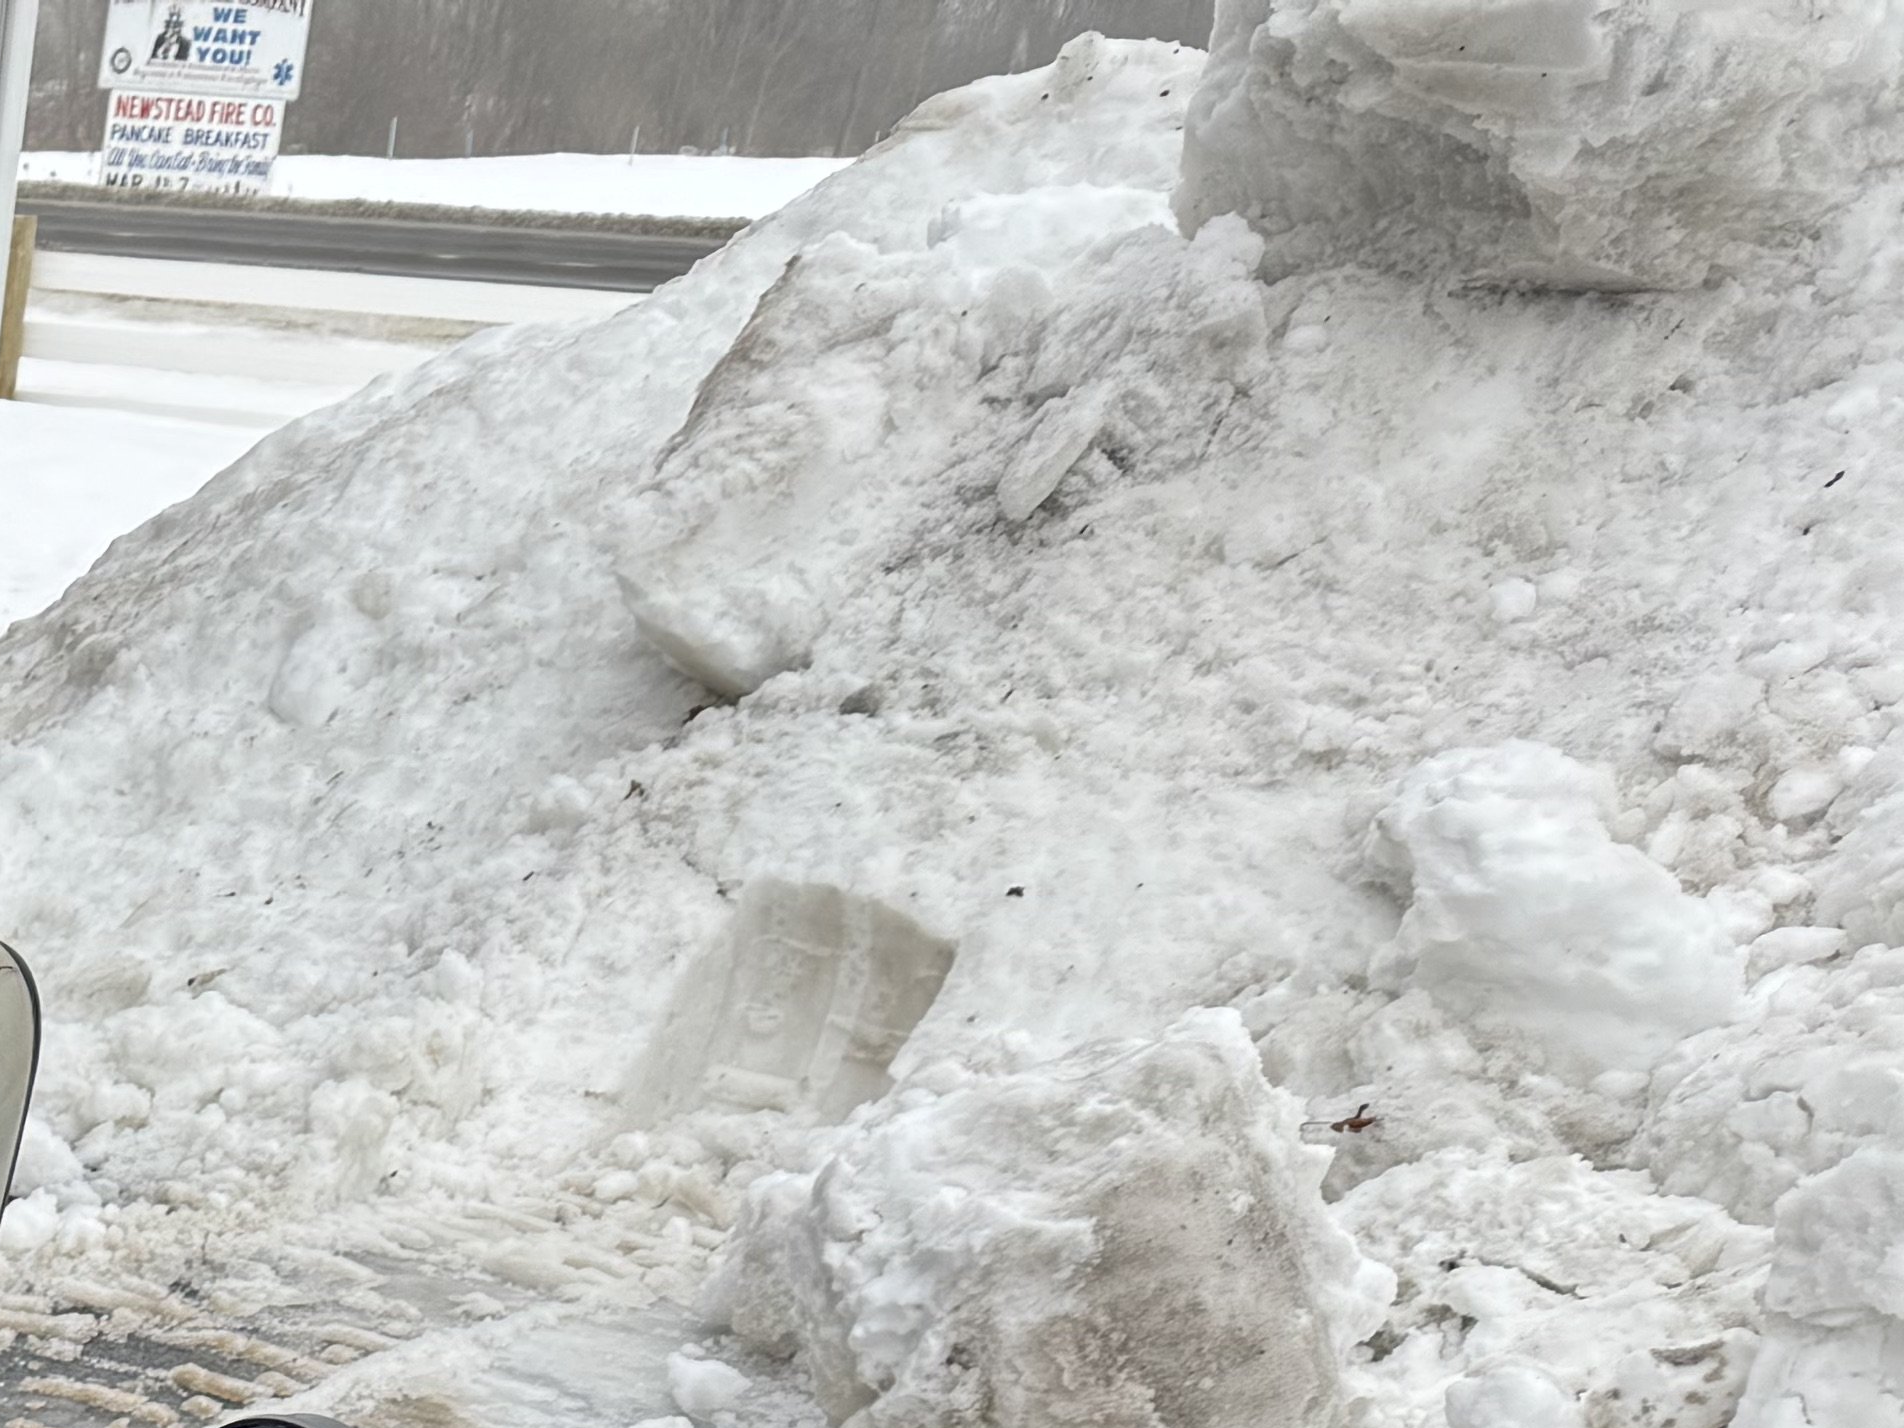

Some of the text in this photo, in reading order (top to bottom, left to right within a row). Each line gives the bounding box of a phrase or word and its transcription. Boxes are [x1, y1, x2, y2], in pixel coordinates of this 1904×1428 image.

[212, 6, 248, 24] WE
[192, 25, 262, 46] WANT
[195, 46, 252, 66] YOU!
[114, 94, 277, 127] NEWSTEAD FIRE CO.
[109, 122, 270, 151] PANCAKE BREAKFAST
